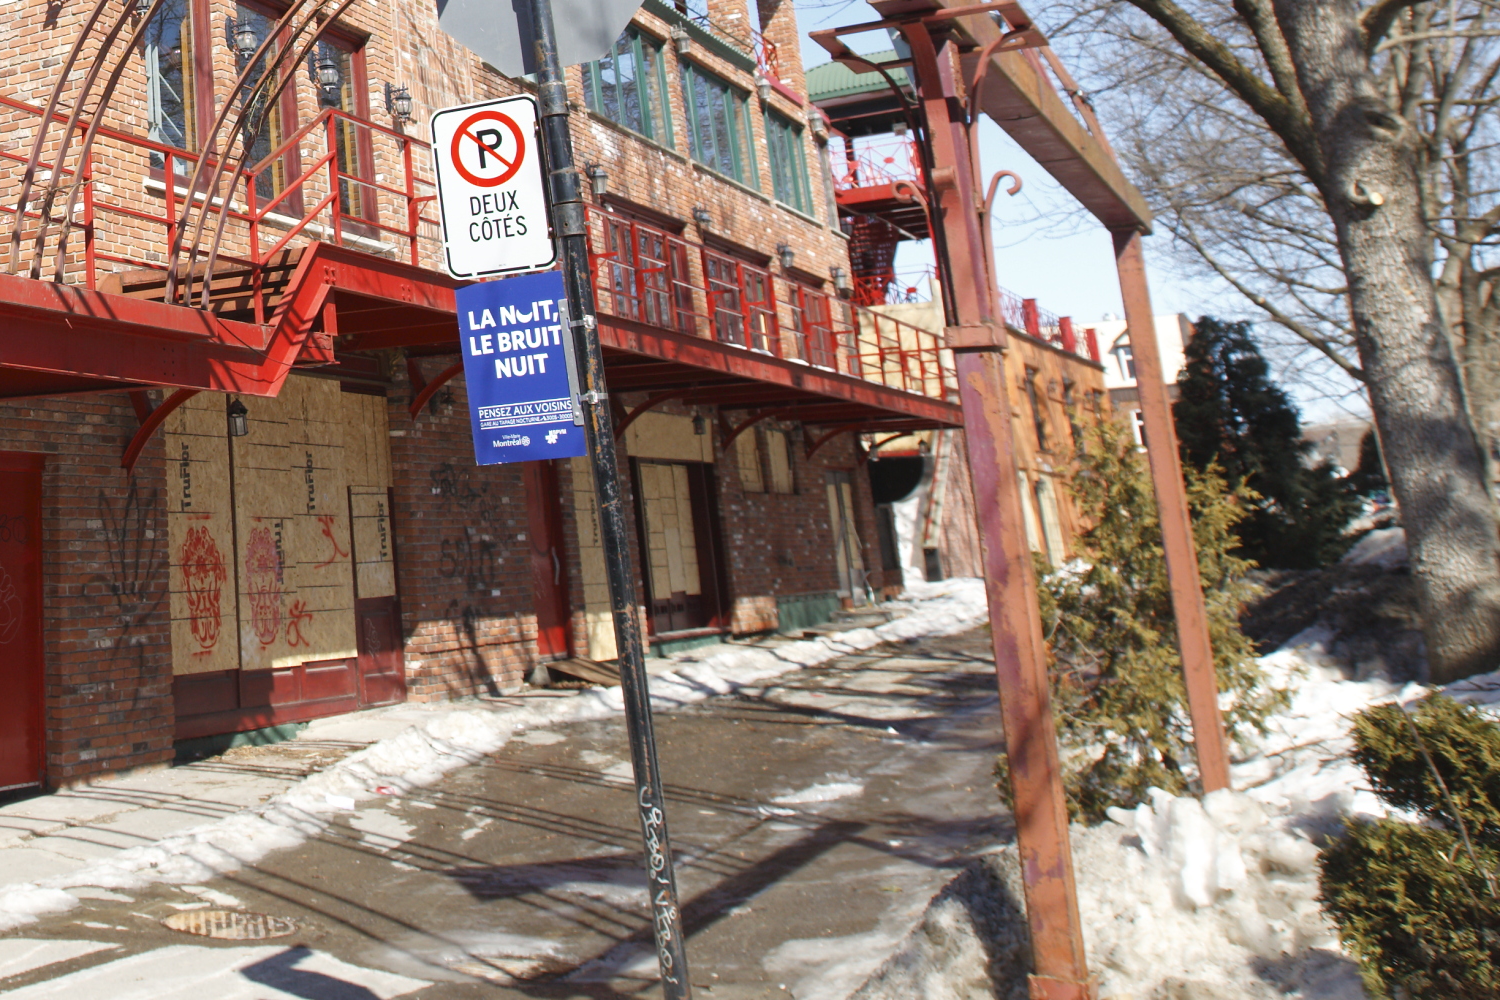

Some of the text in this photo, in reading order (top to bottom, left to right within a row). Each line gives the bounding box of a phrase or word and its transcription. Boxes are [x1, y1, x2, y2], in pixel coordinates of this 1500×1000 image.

[476, 128, 503, 169] P
[469, 190, 520, 217] DEUX
[469, 214, 528, 243] CÔTÉS
[468, 308, 497, 331] LA
[469, 324, 562, 357] LE BRUIT
[494, 352, 549, 379] NUIT
[478, 400, 573, 419] PENSEZ AUX VOISINS
[493, 438, 522, 448] Montréal
[179, 442, 191, 512] TruFlor
[305, 451, 316, 514] TruFlor
